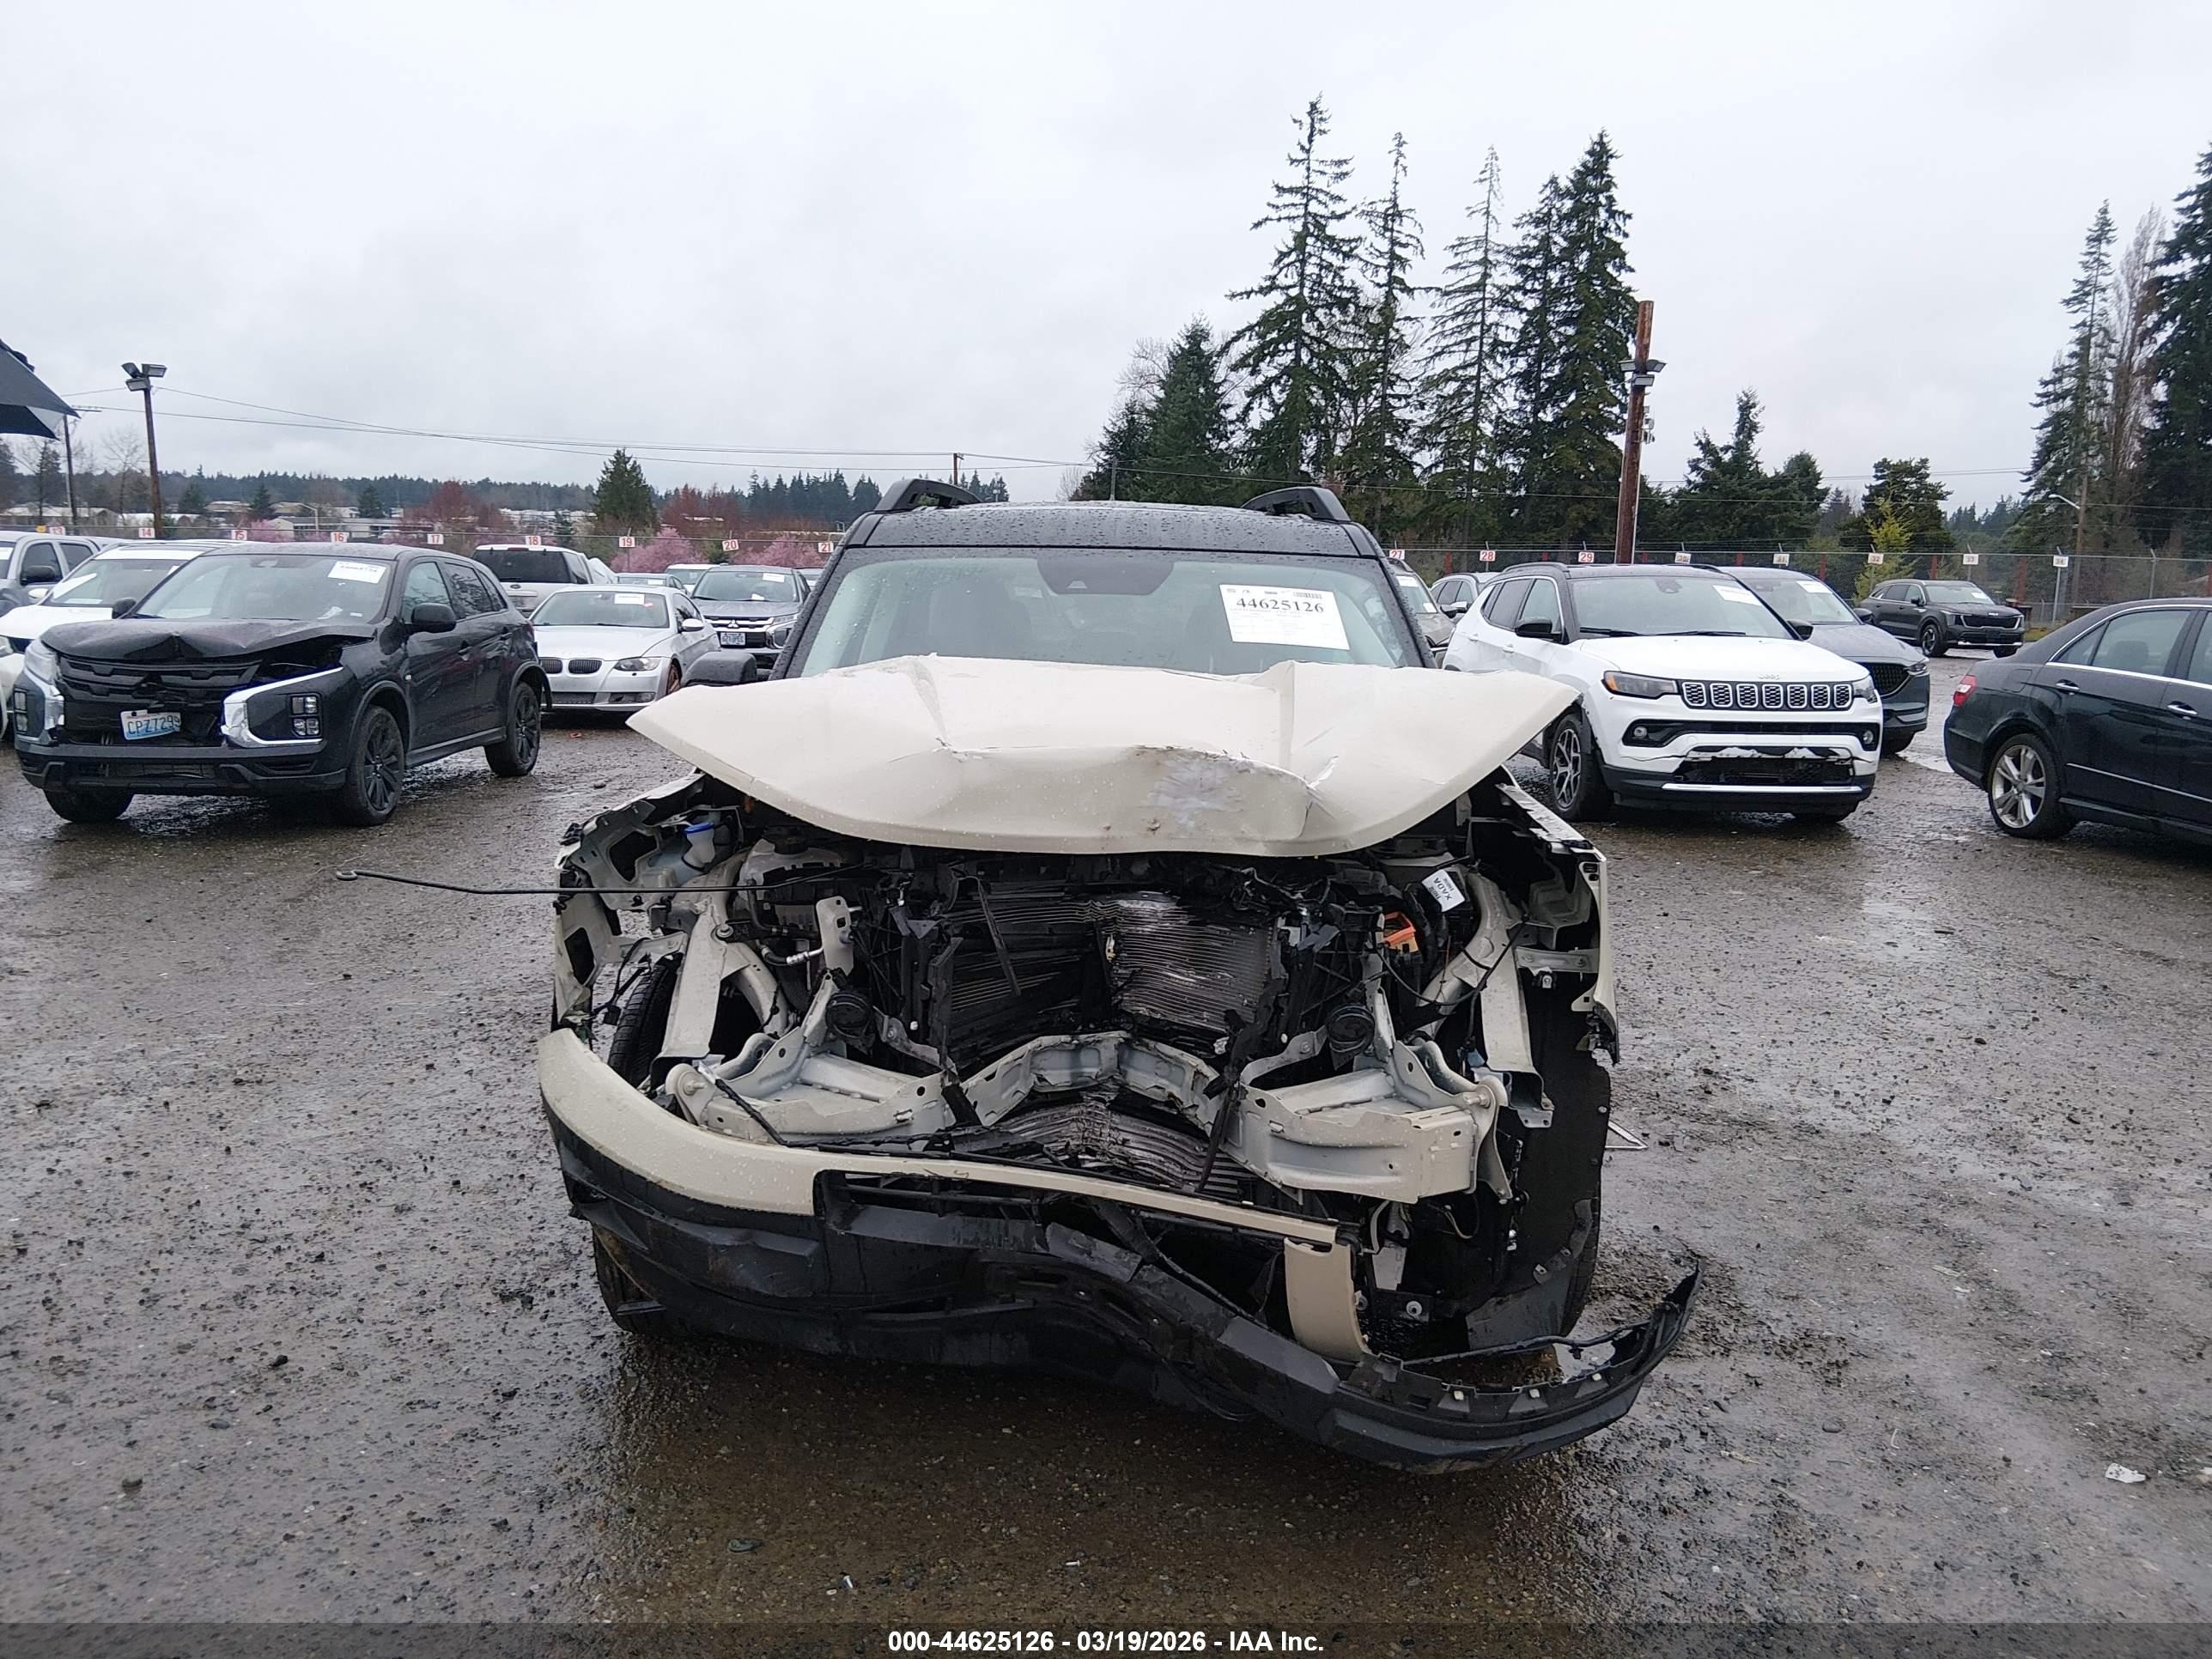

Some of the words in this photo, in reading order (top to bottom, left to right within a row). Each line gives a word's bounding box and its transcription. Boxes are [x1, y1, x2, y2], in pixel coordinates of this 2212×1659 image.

[142, 528, 151, 537] 14
[234, 530, 245, 540] 15
[333, 532, 343, 542] 16
[431, 534, 440, 543] 17
[529, 536, 539, 545] 18
[622, 538, 632, 546] 19
[724, 540, 737, 550] 20
[822, 543, 831, 552] 21
[1391, 550, 1402, 559] 27
[1481, 551, 1494, 561] 28
[1580, 553, 1593, 562] 29
[1237, 597, 1324, 612] 44625126
